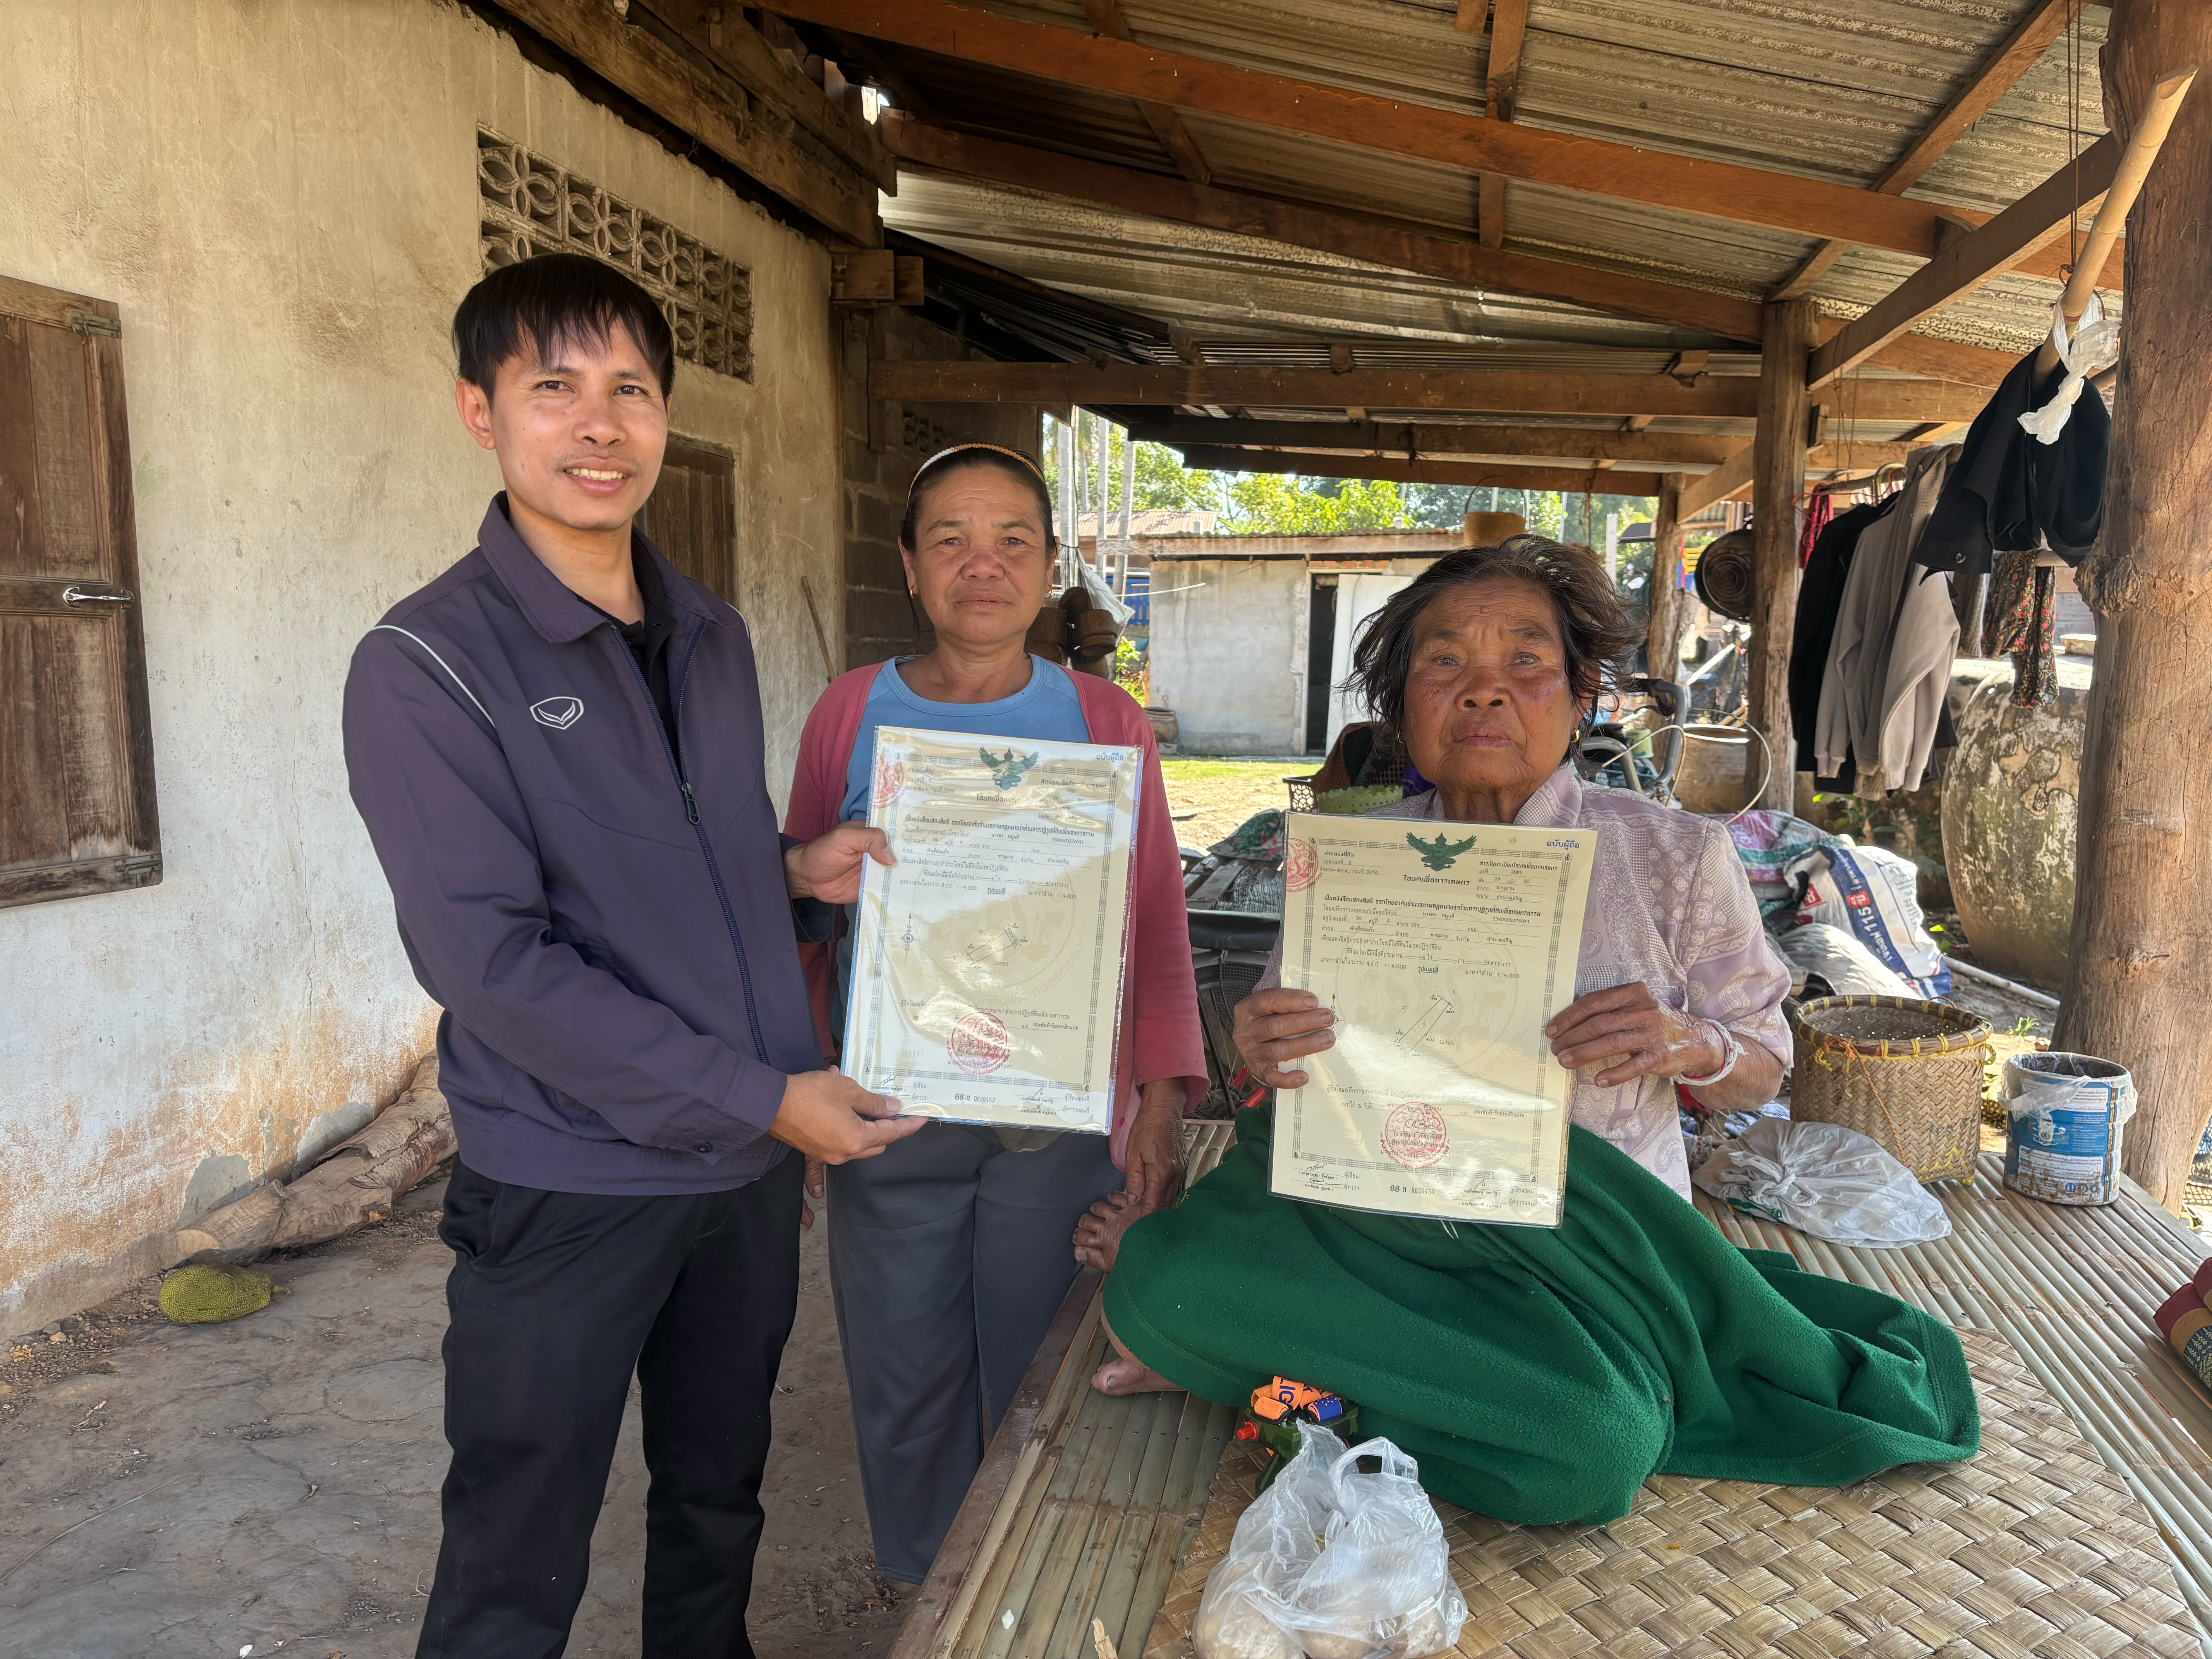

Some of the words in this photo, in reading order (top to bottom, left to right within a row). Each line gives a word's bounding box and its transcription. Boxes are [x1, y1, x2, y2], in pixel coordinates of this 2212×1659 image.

[1096, 752, 1123, 762] ฉบับผู้ถือ
[1546, 839, 1580, 850] ฉบับผู้ถือ
[1403, 874, 1470, 886] โฉนดเพื่อการเกษตร
[1858, 907, 1877, 932] 115
